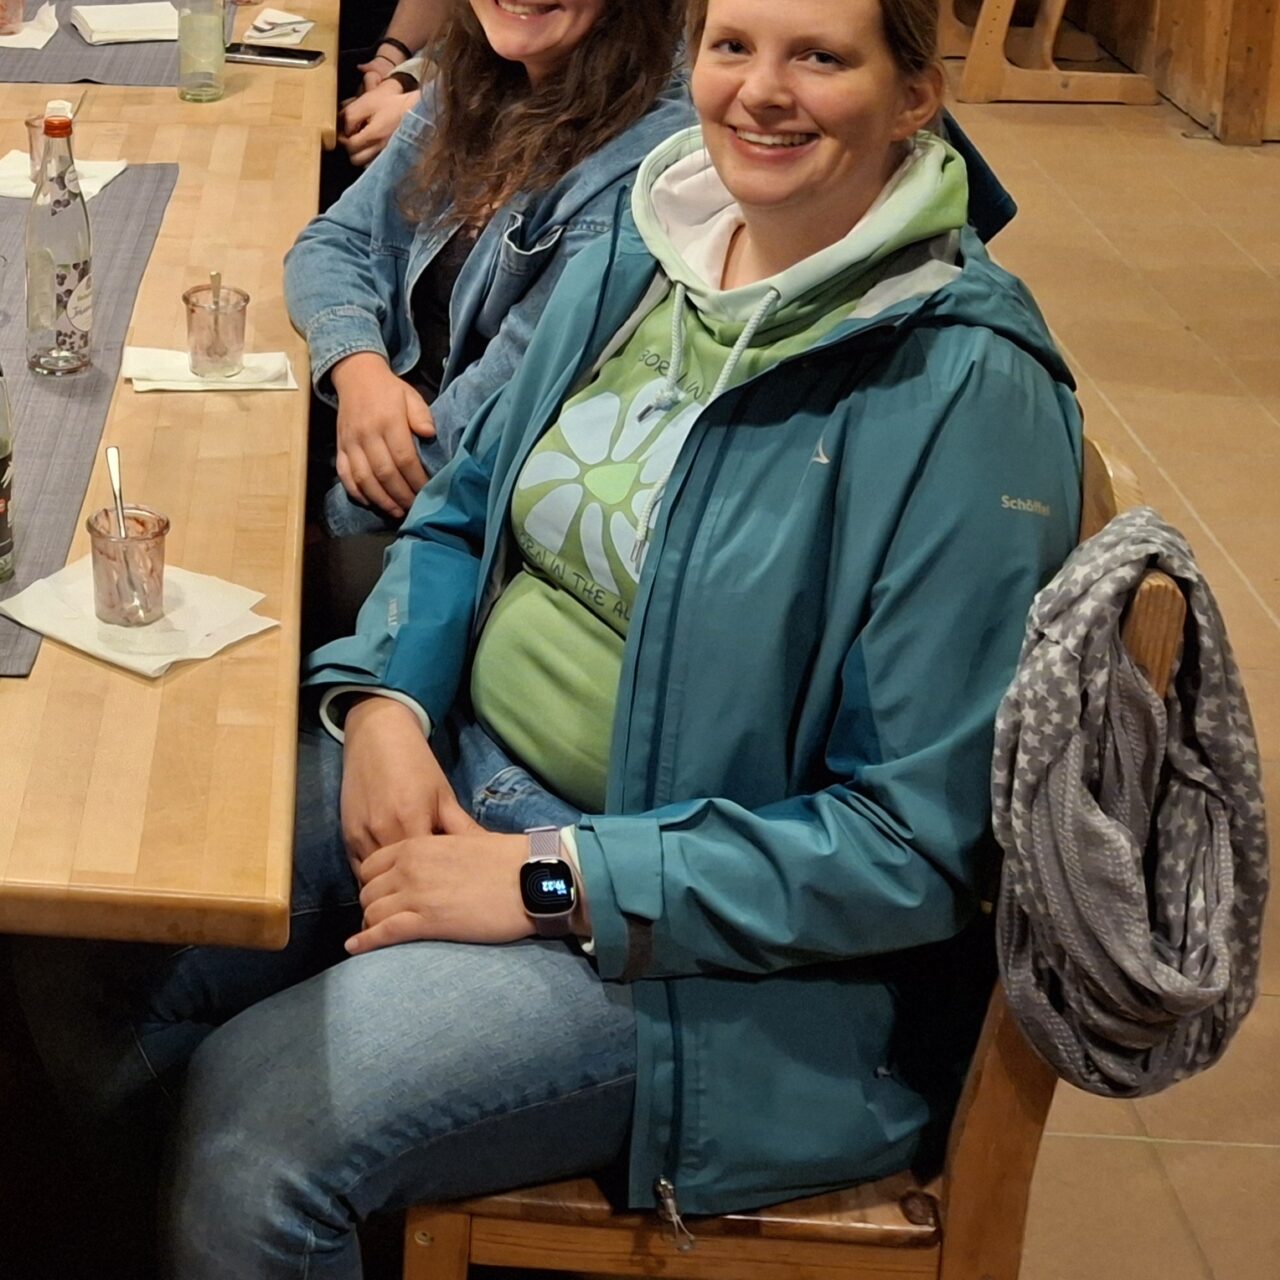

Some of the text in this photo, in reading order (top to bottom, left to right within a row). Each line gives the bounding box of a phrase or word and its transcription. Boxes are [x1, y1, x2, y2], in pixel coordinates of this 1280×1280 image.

[1001, 494, 1052, 517] Schöffel
[518, 532, 631, 622] ORN IN THE AL
